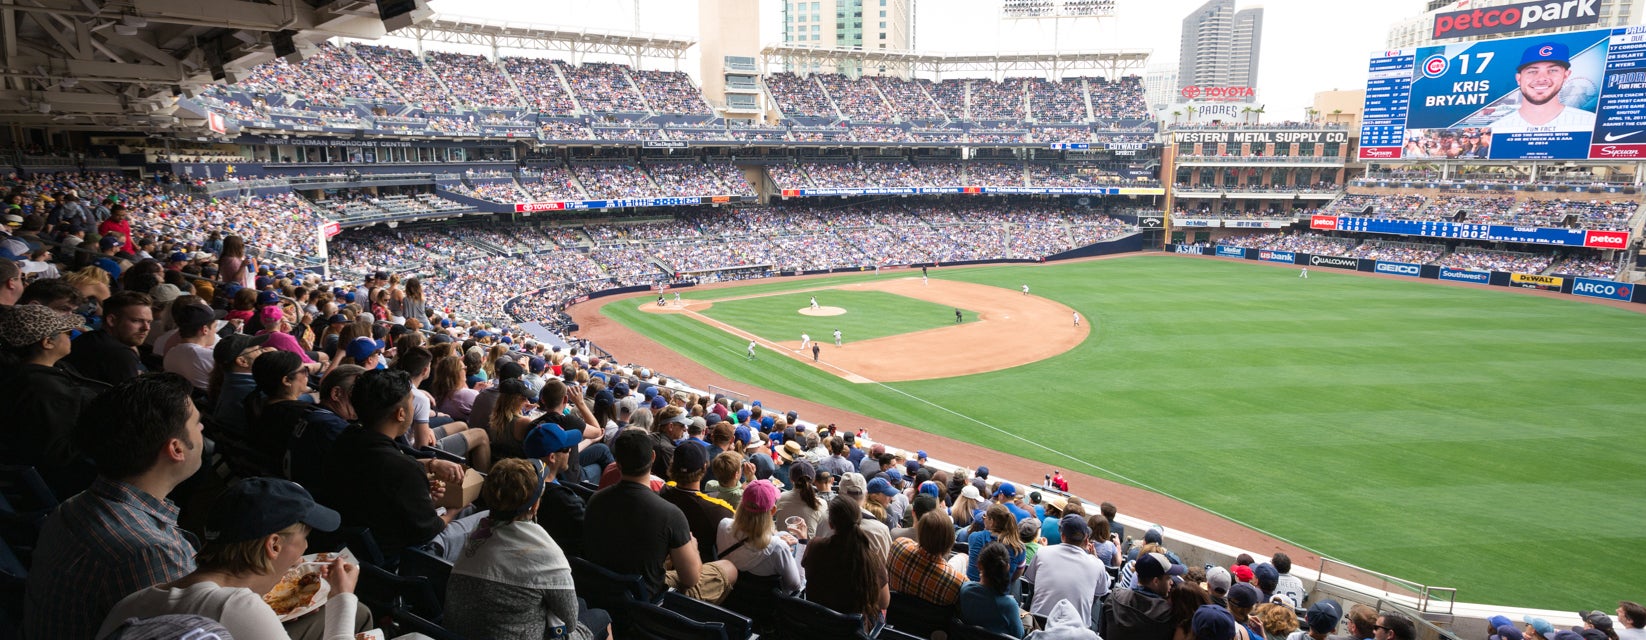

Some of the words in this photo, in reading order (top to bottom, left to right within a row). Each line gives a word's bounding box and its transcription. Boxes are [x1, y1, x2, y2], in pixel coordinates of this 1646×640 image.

[1458, 52, 1494, 74] 17
[1205, 87, 1254, 96] TOYOTA
[1453, 80, 1490, 92] KRIS
[1425, 93, 1489, 107] BRYANT
[1199, 105, 1237, 118] PADRES
[1175, 132, 1228, 142] WESTERN
[1234, 133, 1272, 142] METAL
[1275, 133, 1320, 142] SUPPLY
[1326, 133, 1347, 142] CO.
[1600, 145, 1639, 157] Sycuan
[1176, 245, 1203, 255] ASML
[1312, 256, 1356, 266] QUALCOMM
[1377, 263, 1418, 274] GEICO
[1443, 271, 1481, 280] Southwest
[1575, 282, 1615, 295] ARCO
